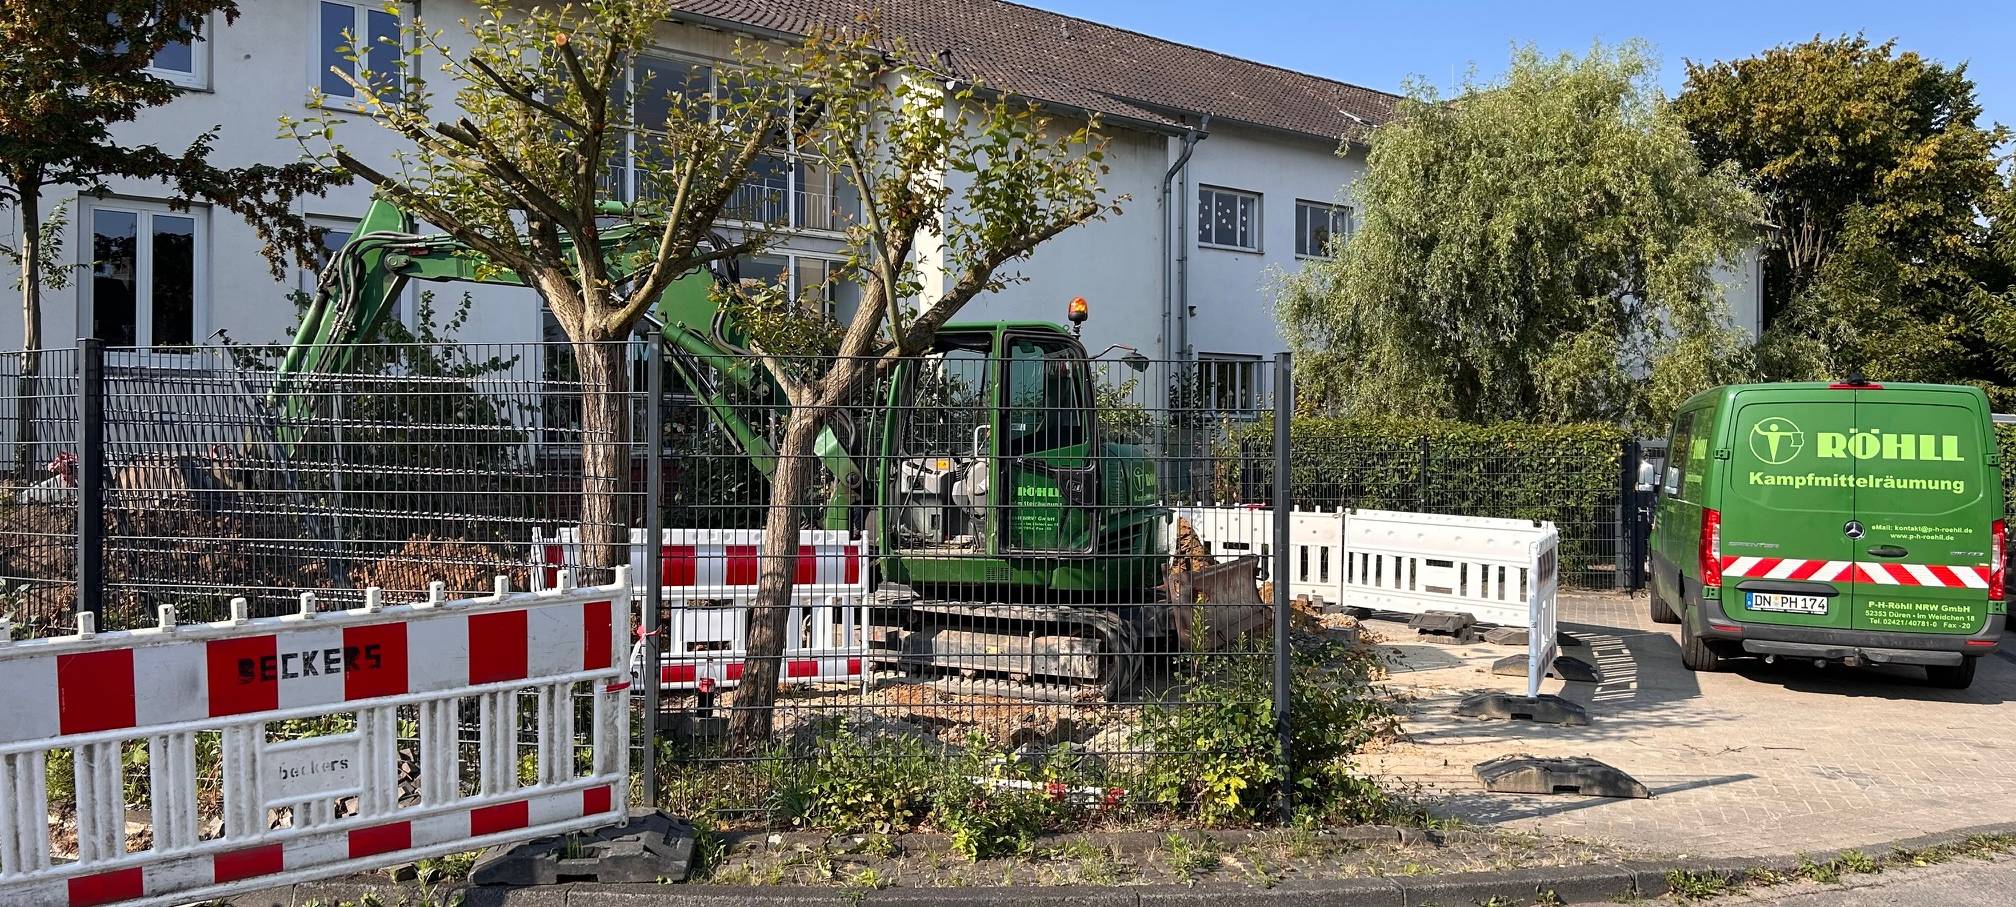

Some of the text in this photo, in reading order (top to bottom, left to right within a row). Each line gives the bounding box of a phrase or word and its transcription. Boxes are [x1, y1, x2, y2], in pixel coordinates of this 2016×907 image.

[1817, 428, 1964, 461] RÖHLL
[1749, 472, 1965, 493] Kampfmittelräumung
[1754, 595, 1825, 610] DN PH 174
[1868, 601, 1971, 613] P-H-Röhll NRW GmbH
[1883, 618, 1937, 627] 02421/40781-0
[238, 644, 381, 684] BECKERS
